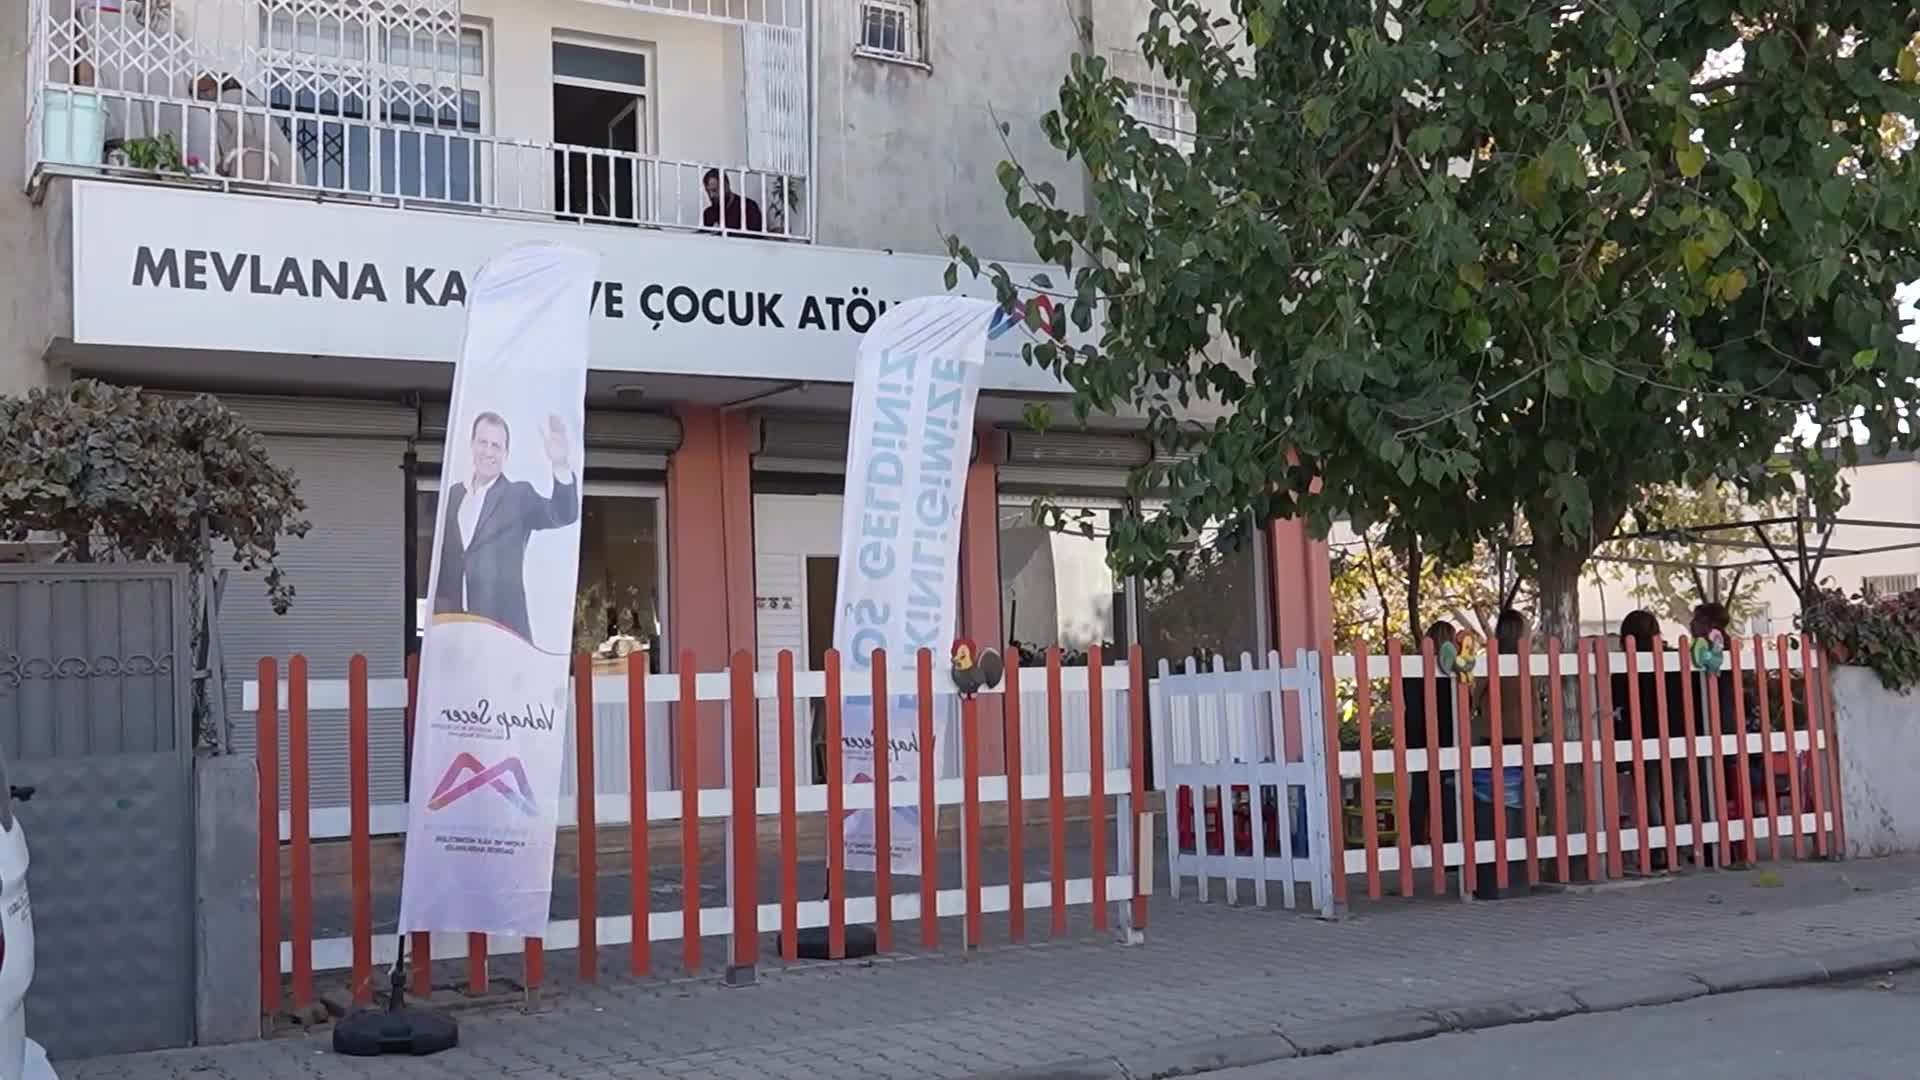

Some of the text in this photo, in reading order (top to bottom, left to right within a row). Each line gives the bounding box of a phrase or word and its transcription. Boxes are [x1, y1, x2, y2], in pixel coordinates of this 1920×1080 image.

[132, 246, 388, 302] MEVLANA
[404, 265, 468, 307] KA
[639, 283, 784, 331] ÇOCUK
